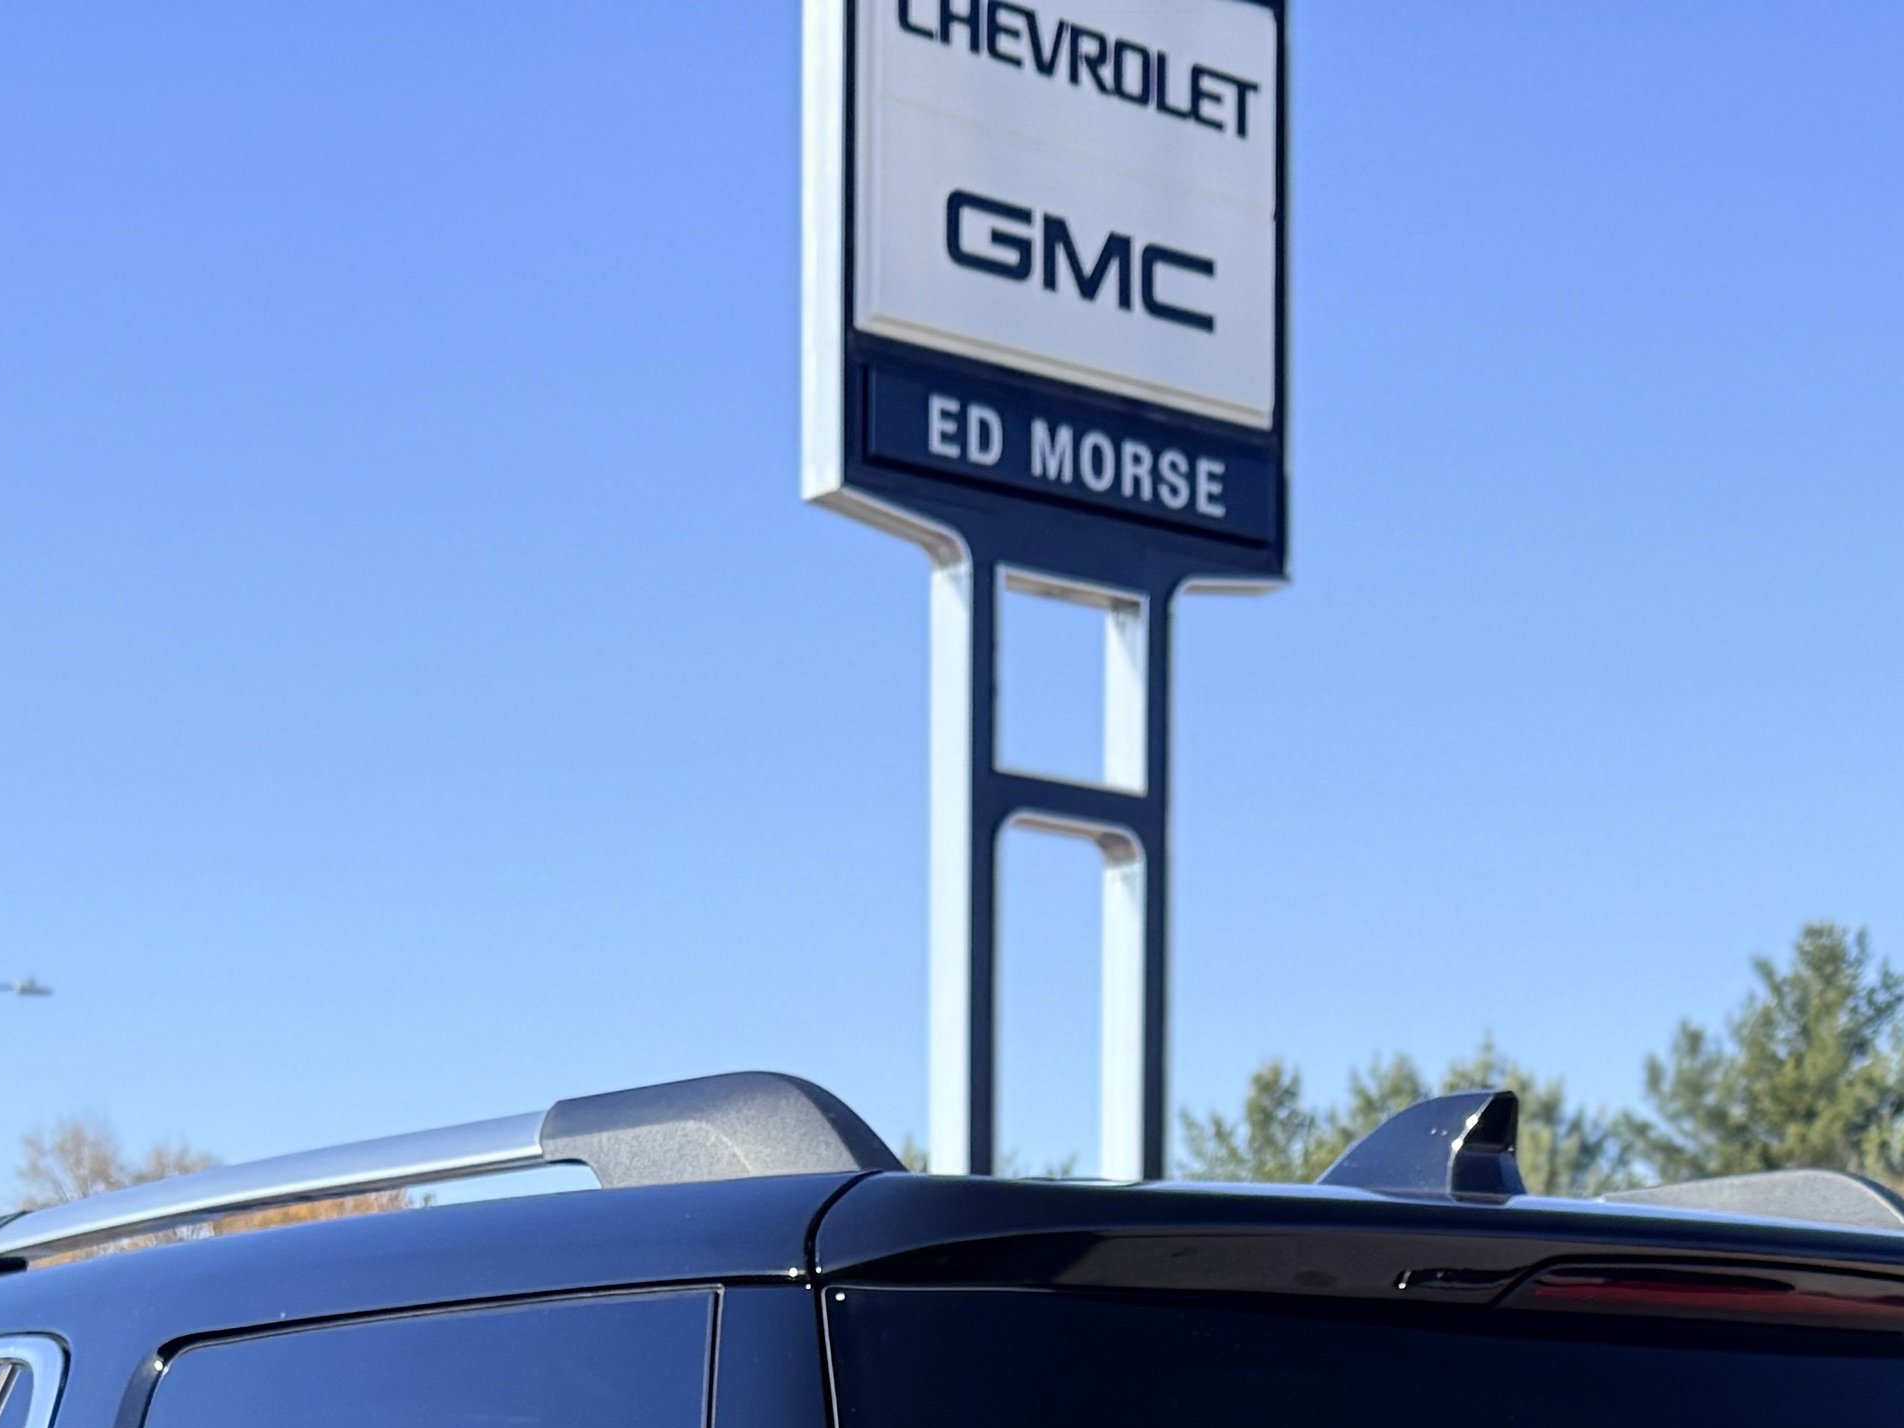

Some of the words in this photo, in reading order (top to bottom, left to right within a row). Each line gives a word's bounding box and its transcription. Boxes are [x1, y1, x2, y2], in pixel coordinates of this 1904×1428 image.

[898, 0, 1260, 139] CHEVROLET
[946, 188, 1215, 334] GMC
[927, 394, 1004, 467] ED
[1030, 418, 1227, 519] MORSE
